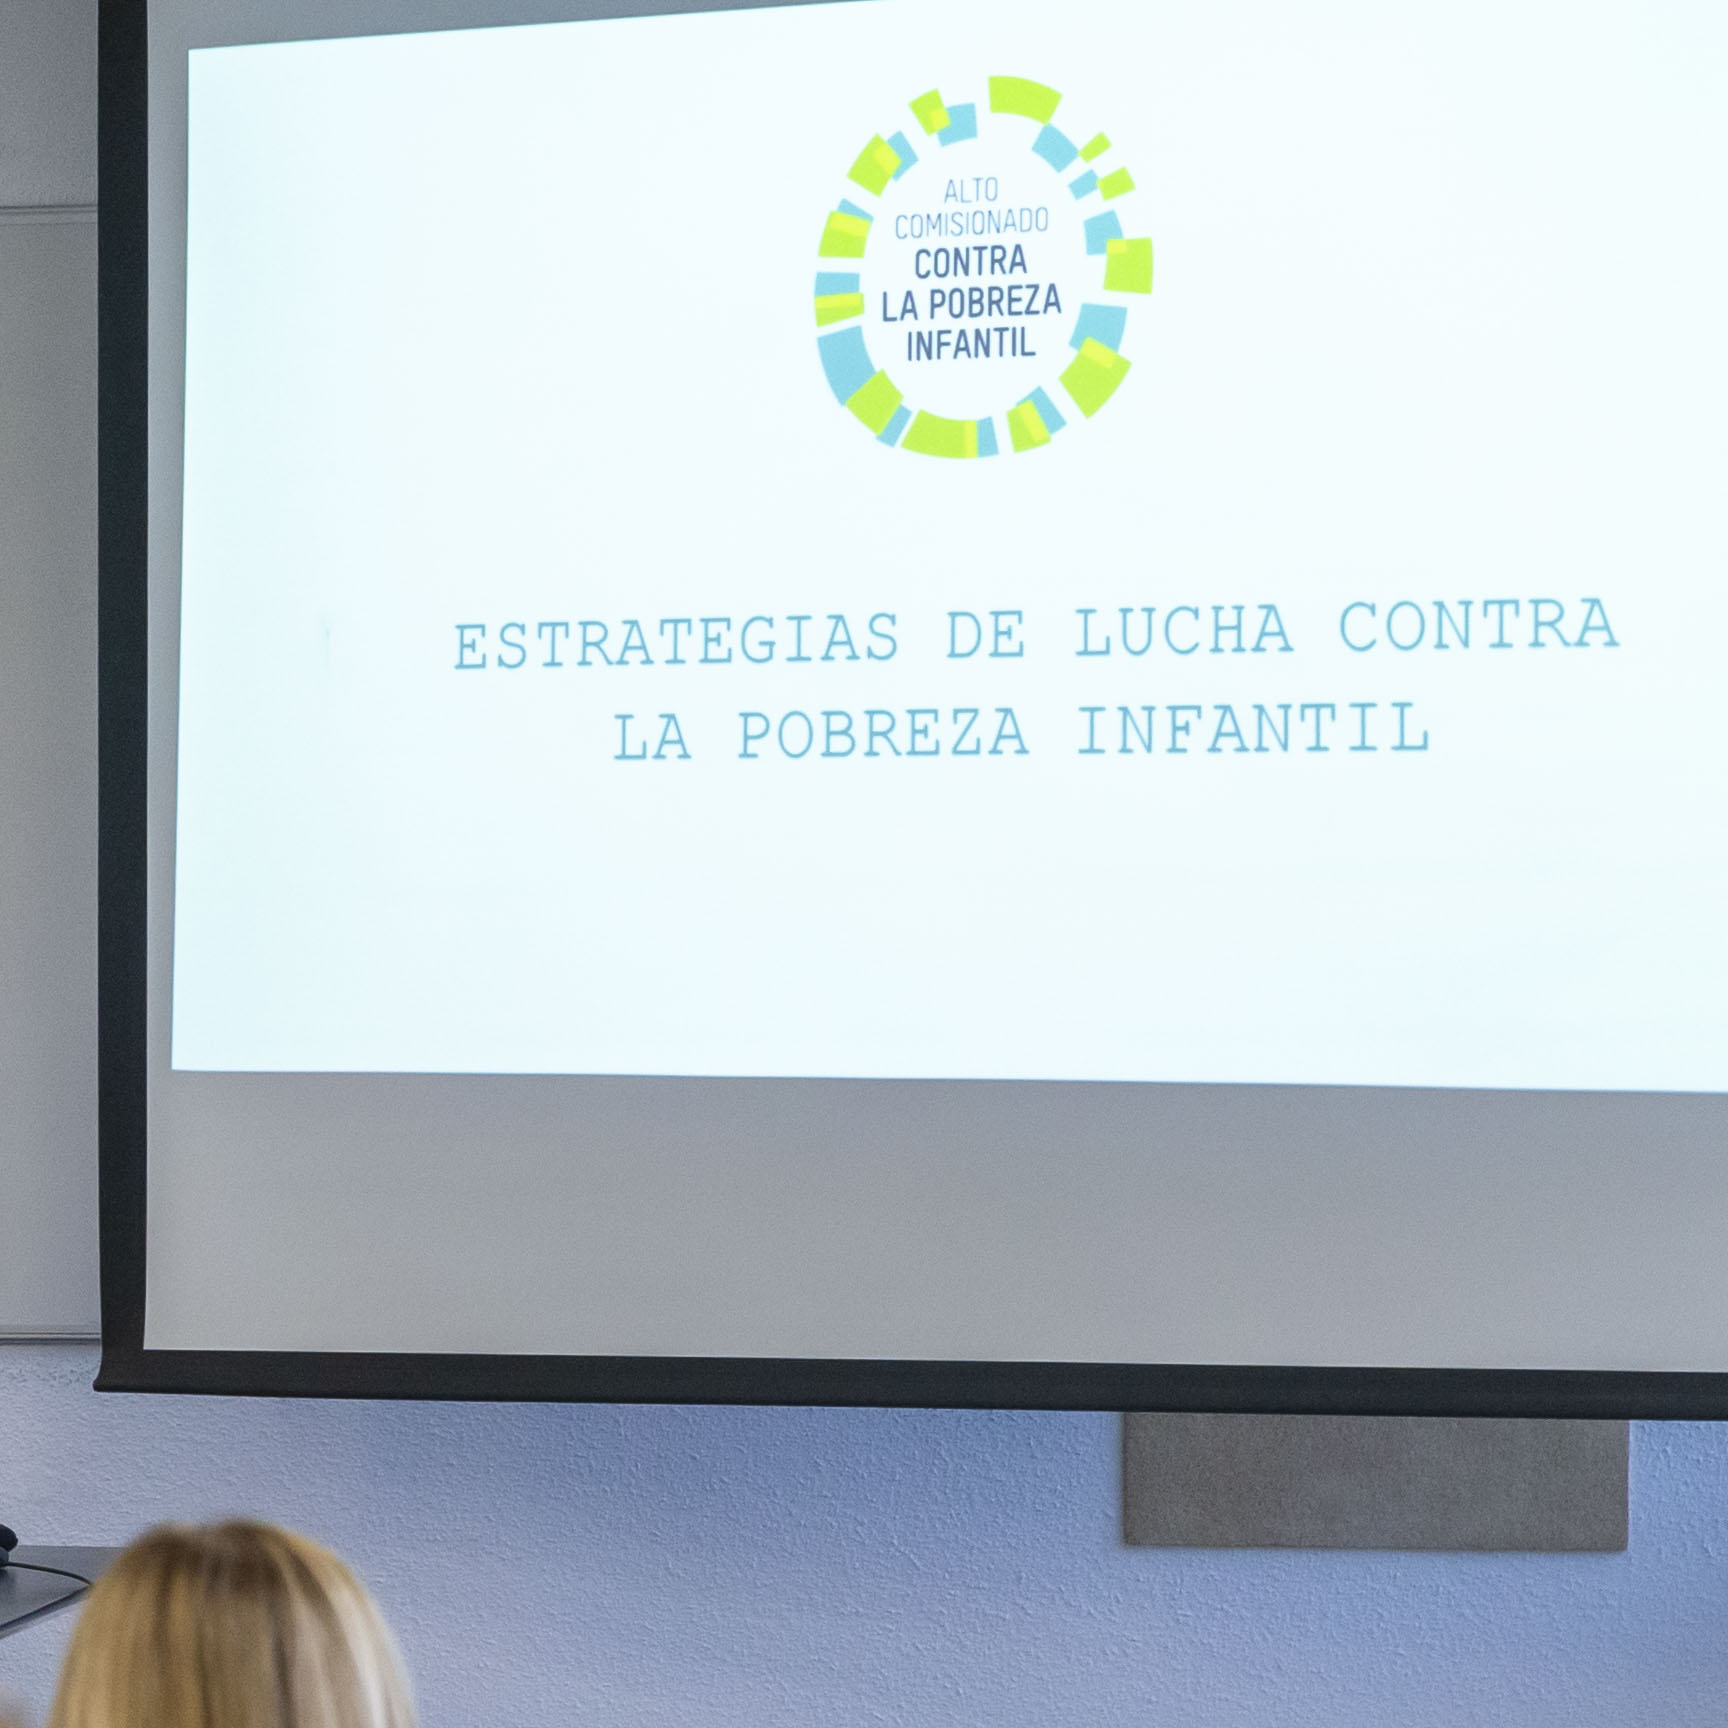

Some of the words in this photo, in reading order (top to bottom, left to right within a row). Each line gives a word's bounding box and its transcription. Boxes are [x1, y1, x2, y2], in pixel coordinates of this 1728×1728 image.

[944, 177, 998, 203] ALTO
[896, 207, 1048, 239] COMISIONADO
[915, 244, 1027, 279] CONTRA
[883, 290, 918, 322] LA
[930, 283, 1061, 319] POBREZA
[908, 327, 1036, 361] INFANTIL
[454, 613, 897, 670] ESTRATEGIAS
[947, 610, 1024, 658] DE
[1076, 604, 1294, 656] LUCHA
[1340, 598, 1620, 652] CONTRA
[614, 713, 691, 760] LA
[738, 707, 1029, 759] POBREZA
[1078, 702, 1428, 754] INFANTIL
